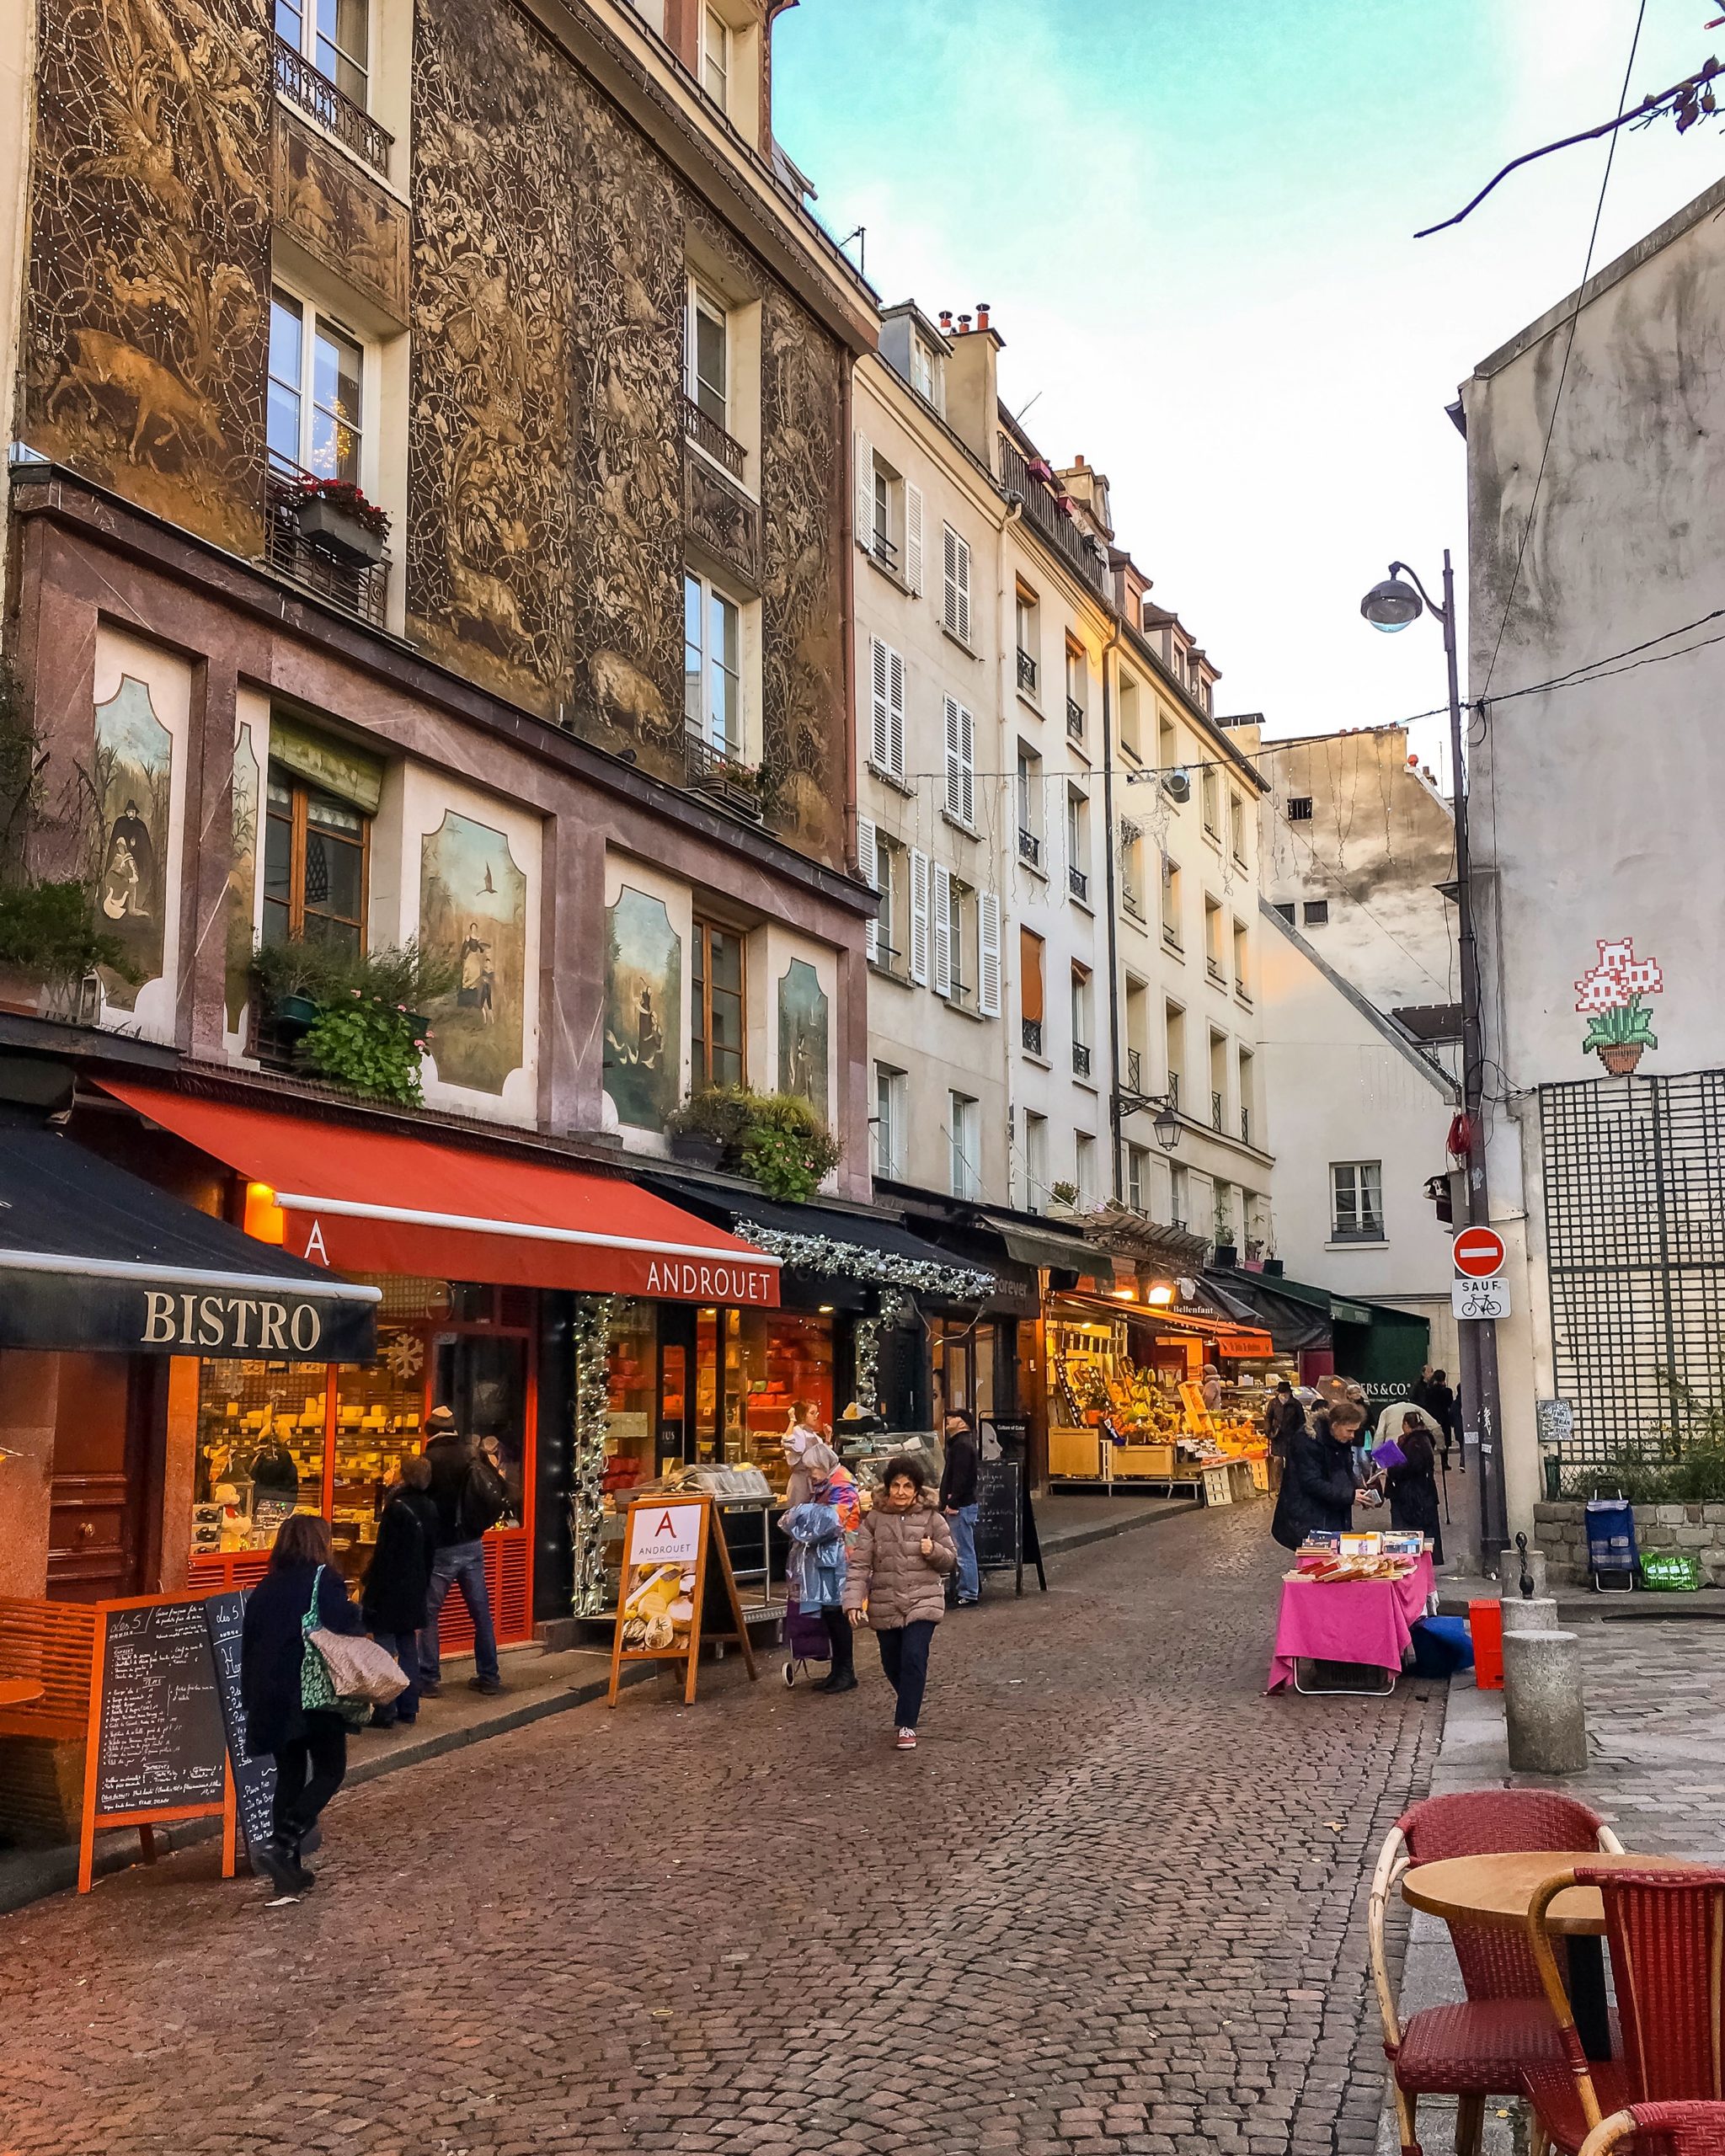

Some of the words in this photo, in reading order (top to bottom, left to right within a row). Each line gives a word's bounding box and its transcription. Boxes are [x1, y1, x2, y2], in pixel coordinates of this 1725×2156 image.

[304, 1219, 330, 1266] A
[646, 1262, 771, 1300] ANDROUET
[1461, 1280, 1498, 1292] SAUF
[141, 1291, 321, 1352] BISTRO
[1173, 1305, 1214, 1314] Bellenfant
[654, 1510, 676, 1538] A
[639, 1544, 691, 1555] ANDROUET
